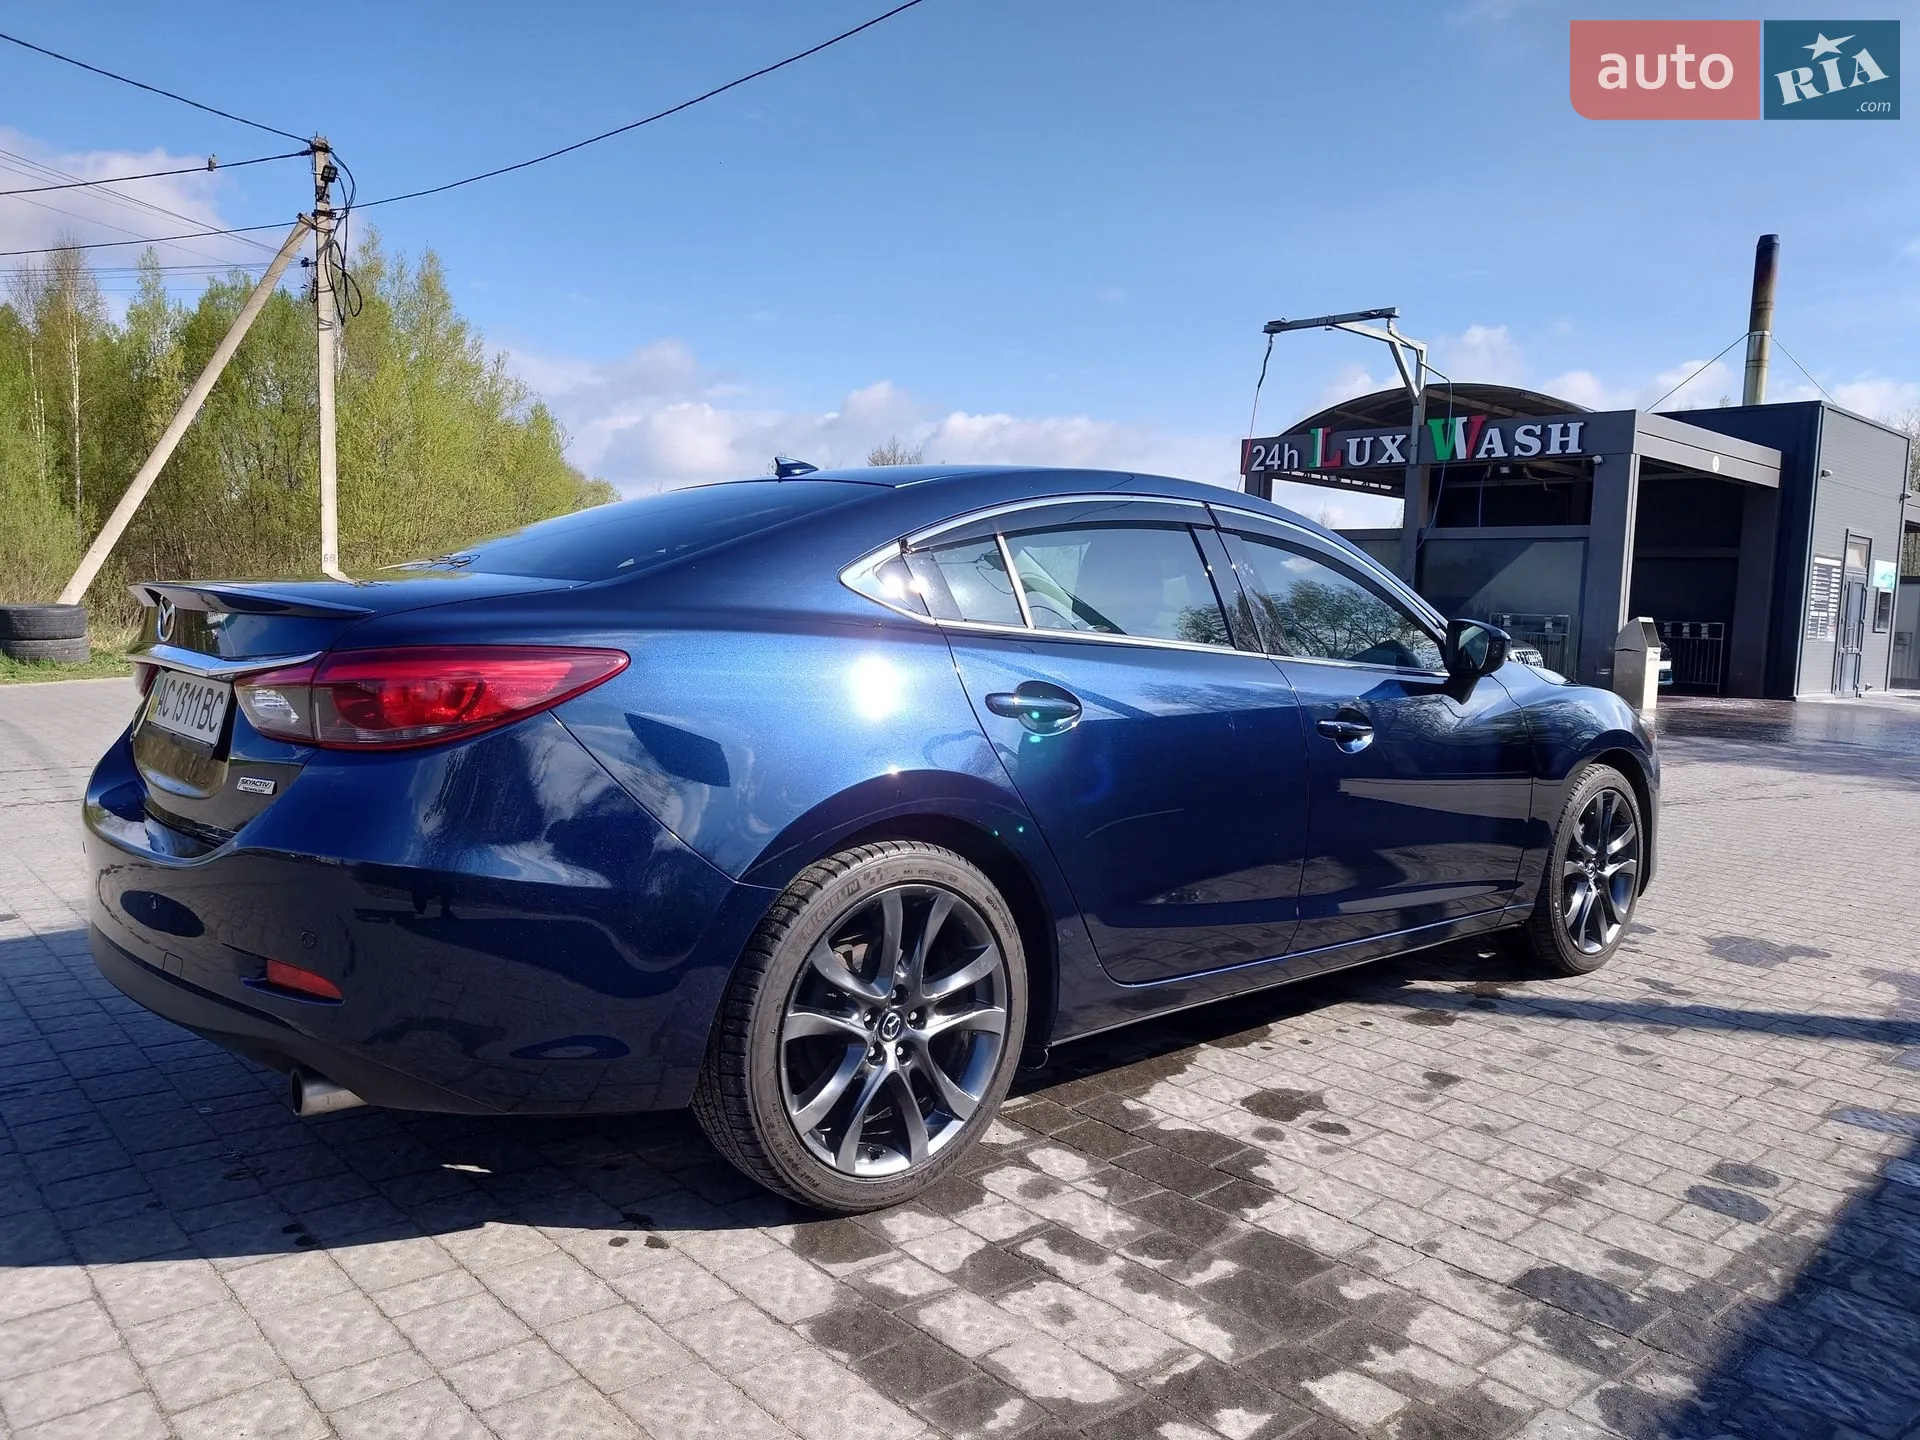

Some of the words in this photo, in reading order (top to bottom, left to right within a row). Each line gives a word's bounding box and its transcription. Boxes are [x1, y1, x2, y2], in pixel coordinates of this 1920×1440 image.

[1251, 443, 1299, 472] 24h
[1309, 427, 1407, 467] LUX
[1427, 414, 1584, 461] WASH
[801, 878, 861, 940] MICHELIN
